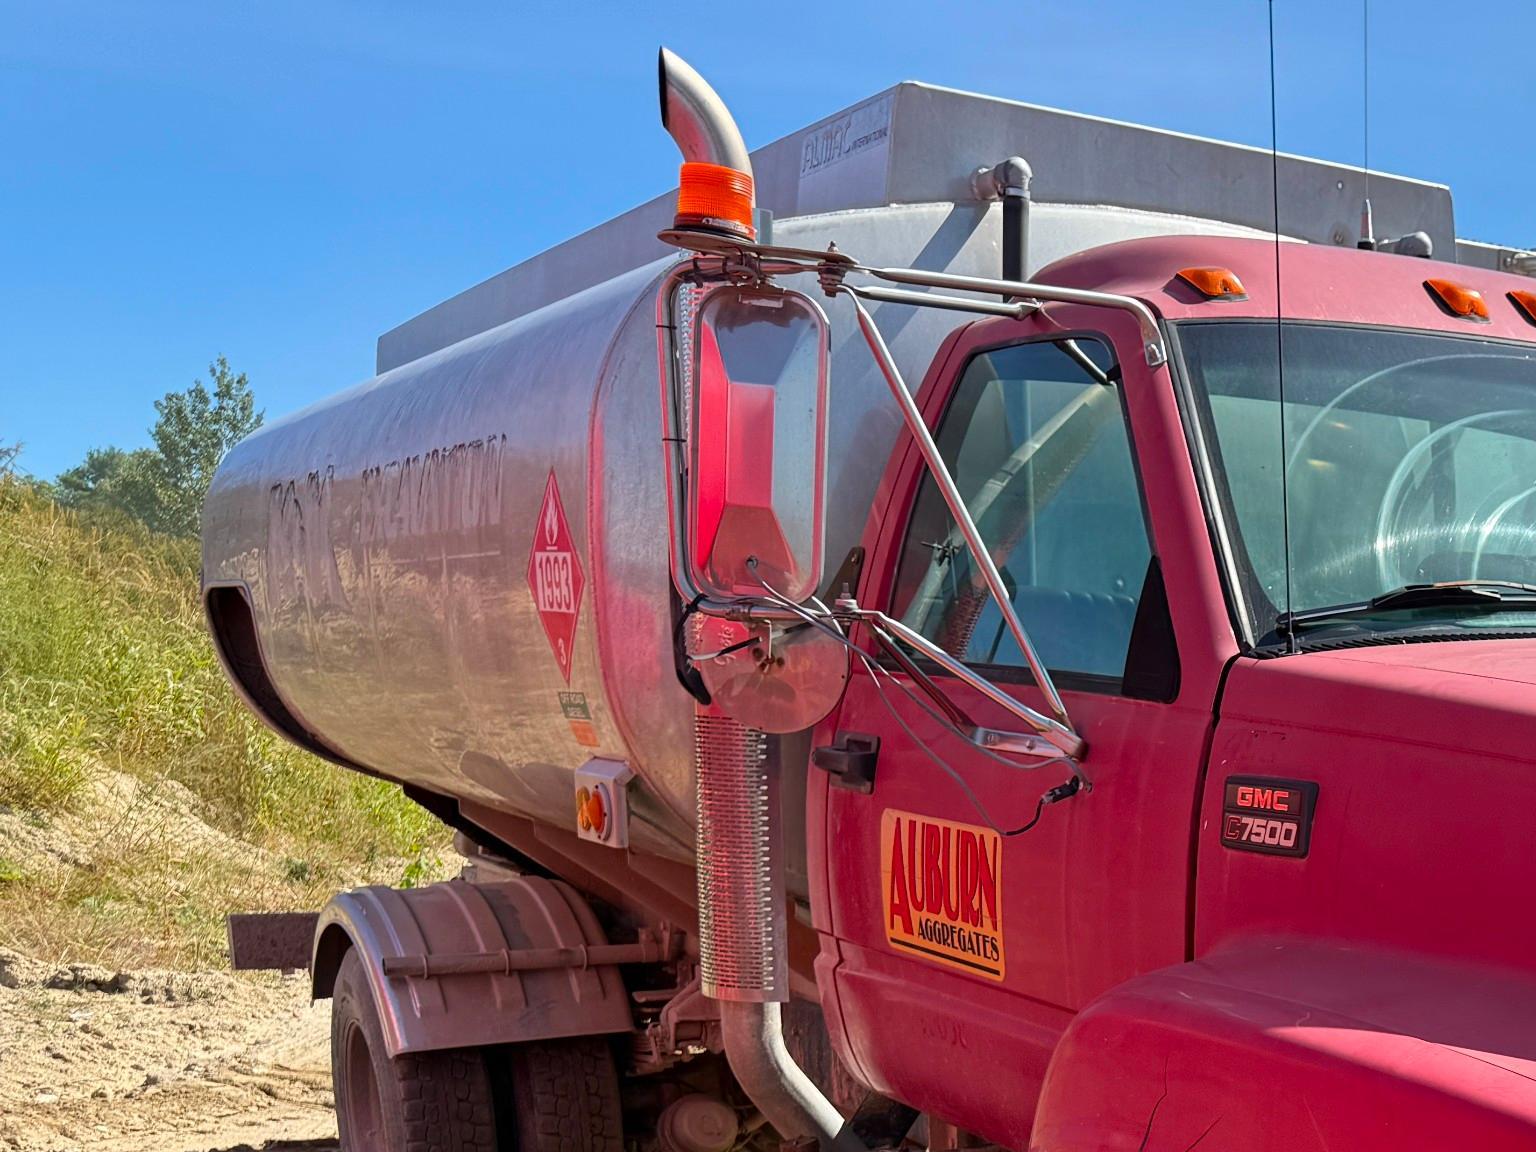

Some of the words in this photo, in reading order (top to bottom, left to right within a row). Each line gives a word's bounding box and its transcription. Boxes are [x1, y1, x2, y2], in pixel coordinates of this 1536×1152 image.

[538, 554, 572, 611] 1993
[558, 637, 568, 665] 3
[1236, 786, 1289, 811] GMC
[1223, 815, 1298, 847] C7500
[889, 817, 998, 936] AUBURN
[917, 916, 1000, 962] AGGREGATES
